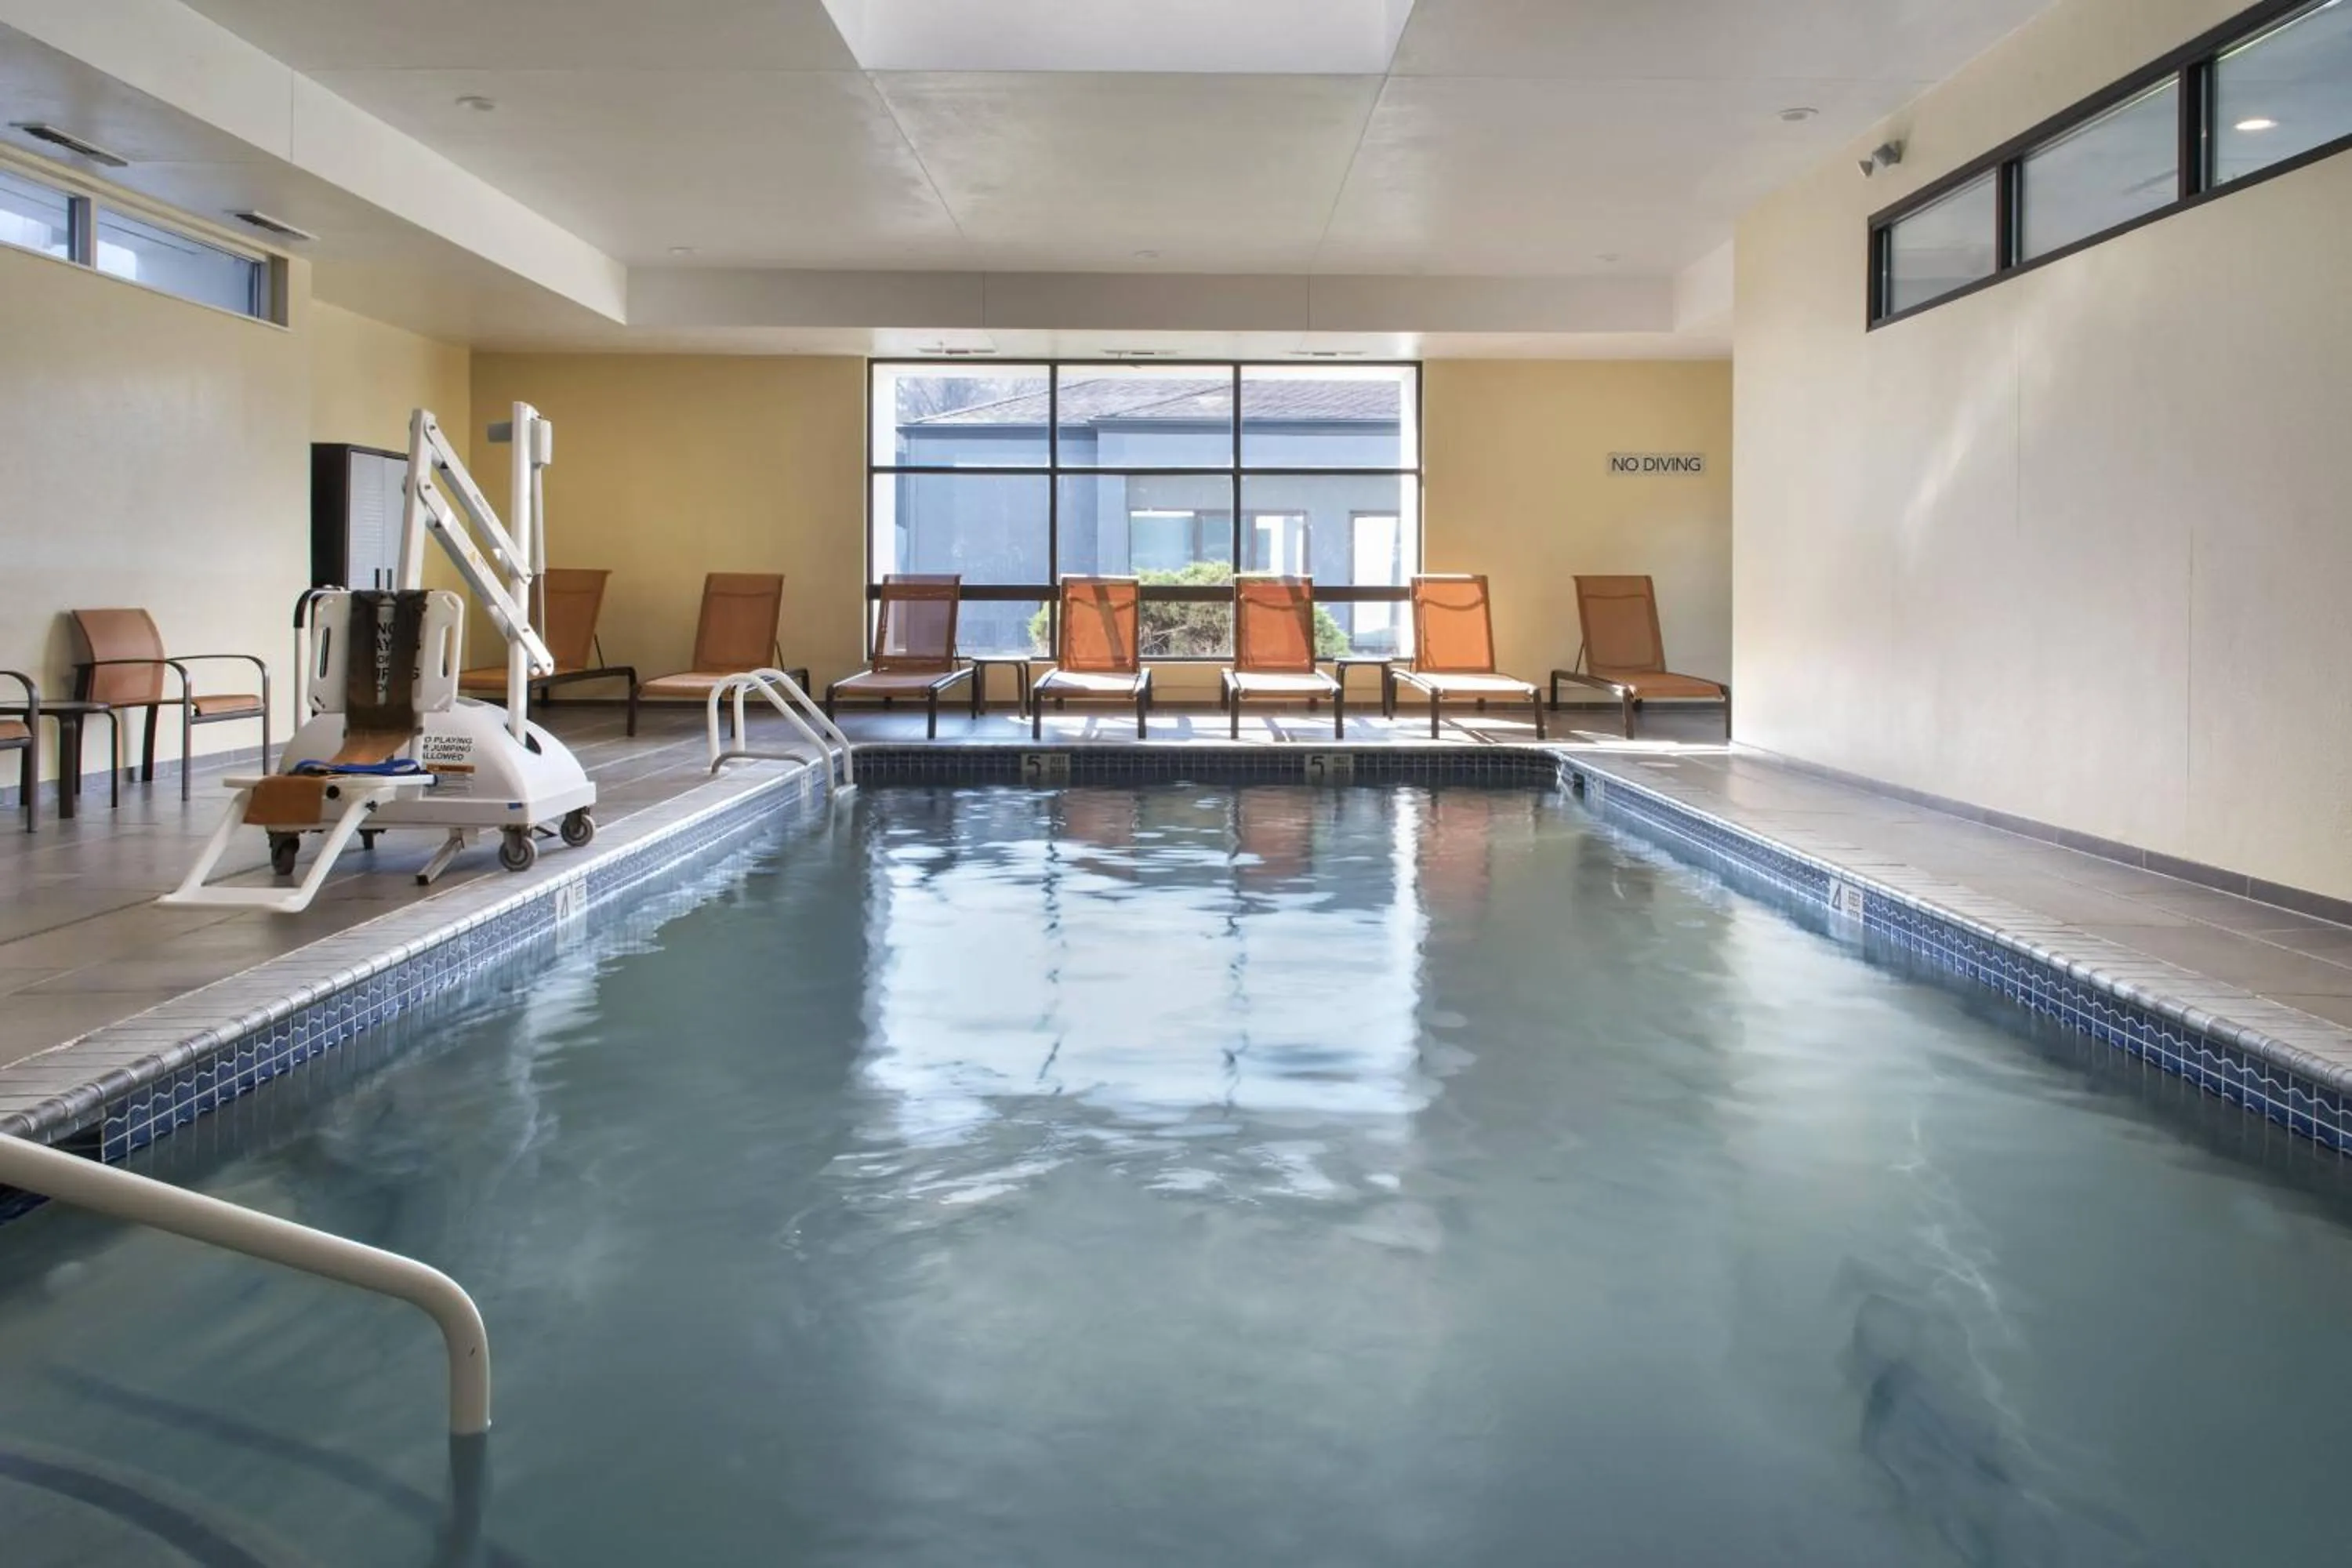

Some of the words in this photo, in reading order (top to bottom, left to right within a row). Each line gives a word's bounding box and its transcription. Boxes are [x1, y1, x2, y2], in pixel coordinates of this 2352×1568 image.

[1612, 458, 1639, 471] NO
[1643, 457, 1701, 471] DIVING
[430, 744, 472, 753] JUMPING
[1027, 755, 1041, 777] 5
[1311, 755, 1325, 775] 5
